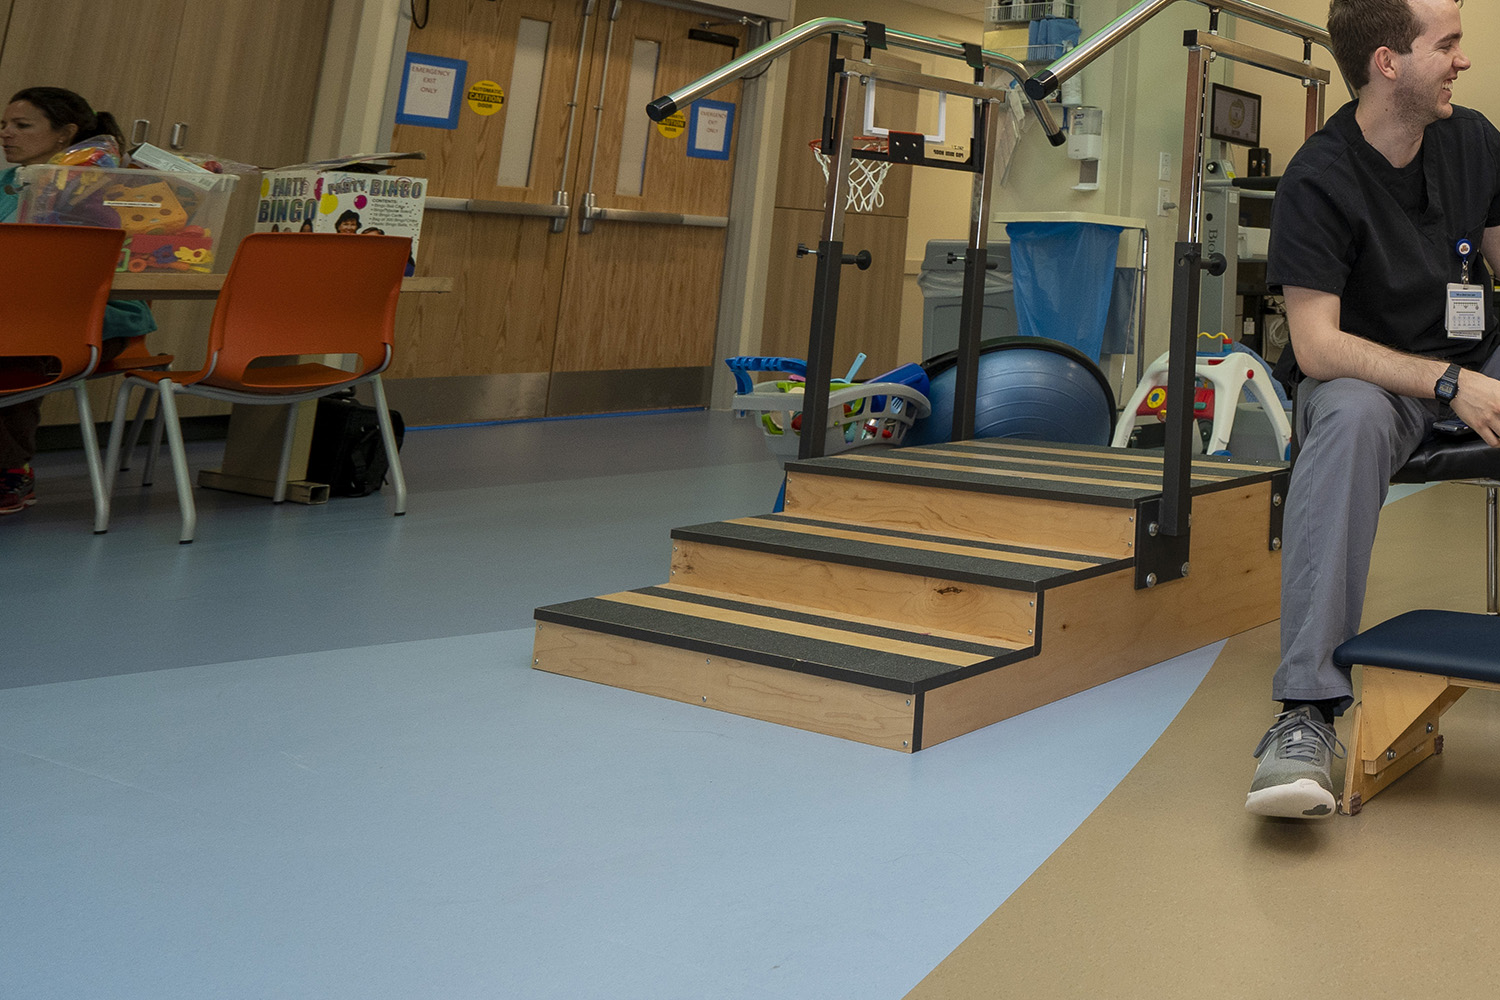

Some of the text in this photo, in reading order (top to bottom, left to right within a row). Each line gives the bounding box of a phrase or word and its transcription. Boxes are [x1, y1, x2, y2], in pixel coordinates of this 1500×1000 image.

[411, 66, 450, 77] EMERGENCY
[420, 86, 437, 94] ONLY
[469, 93, 502, 103] CAUTION
[272, 177, 306, 197] PARTY
[327, 179, 422, 199] PARTY BINGO
[257, 198, 317, 223] BINGO
